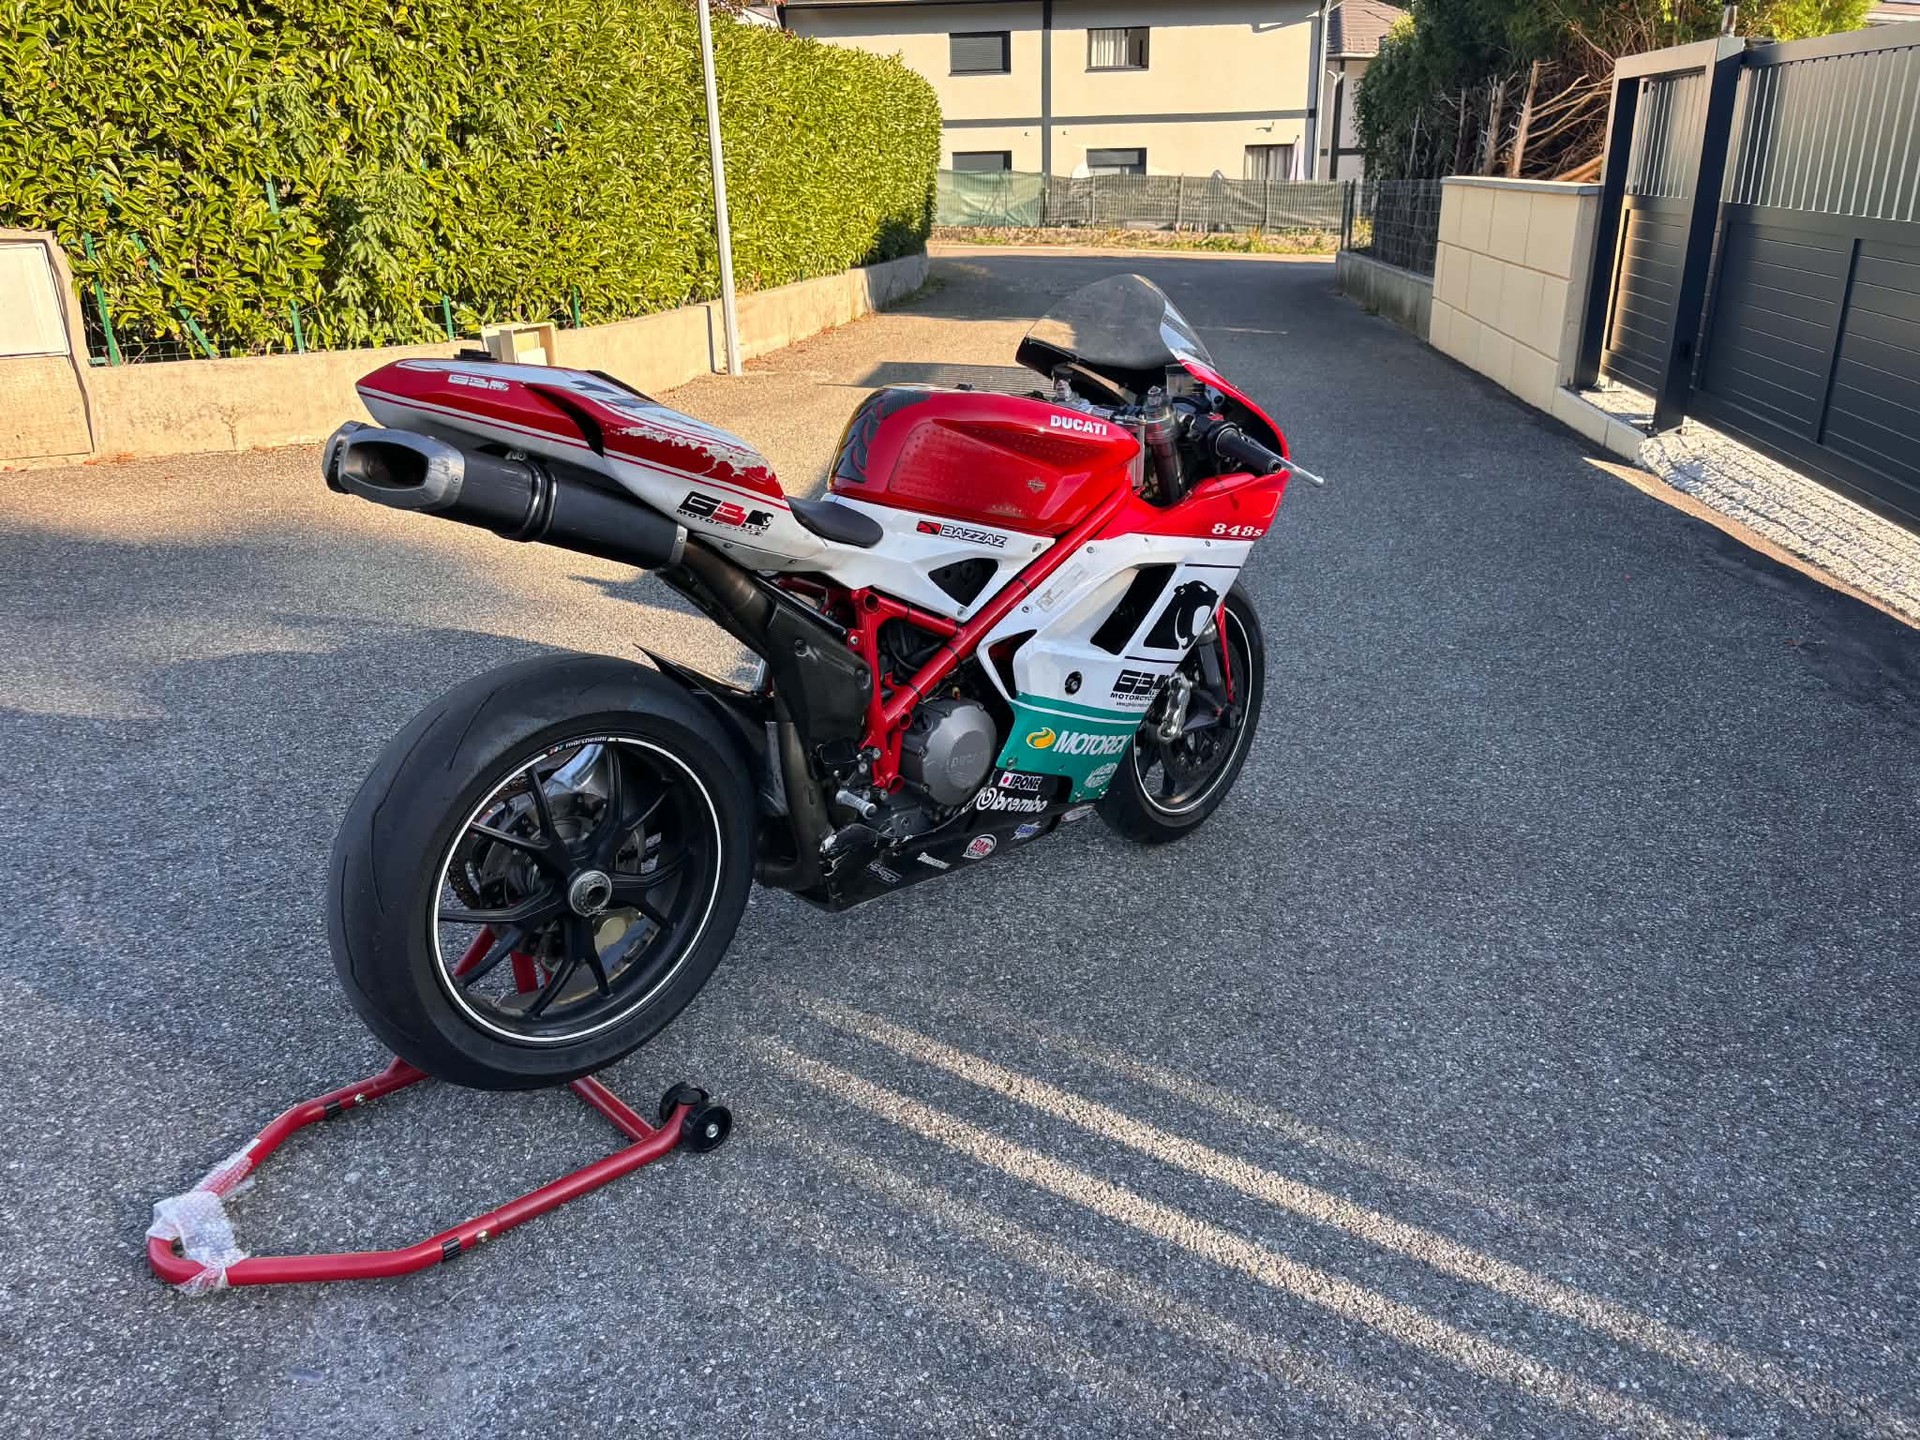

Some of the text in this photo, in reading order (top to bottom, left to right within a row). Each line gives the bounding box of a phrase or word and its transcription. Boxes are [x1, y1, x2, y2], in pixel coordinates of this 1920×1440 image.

[1050, 414, 1108, 436] DUCATI
[940, 524, 1008, 548] BAZZAZ
[1009, 774, 1042, 791] IPONE
[990, 790, 1048, 812] brembo
